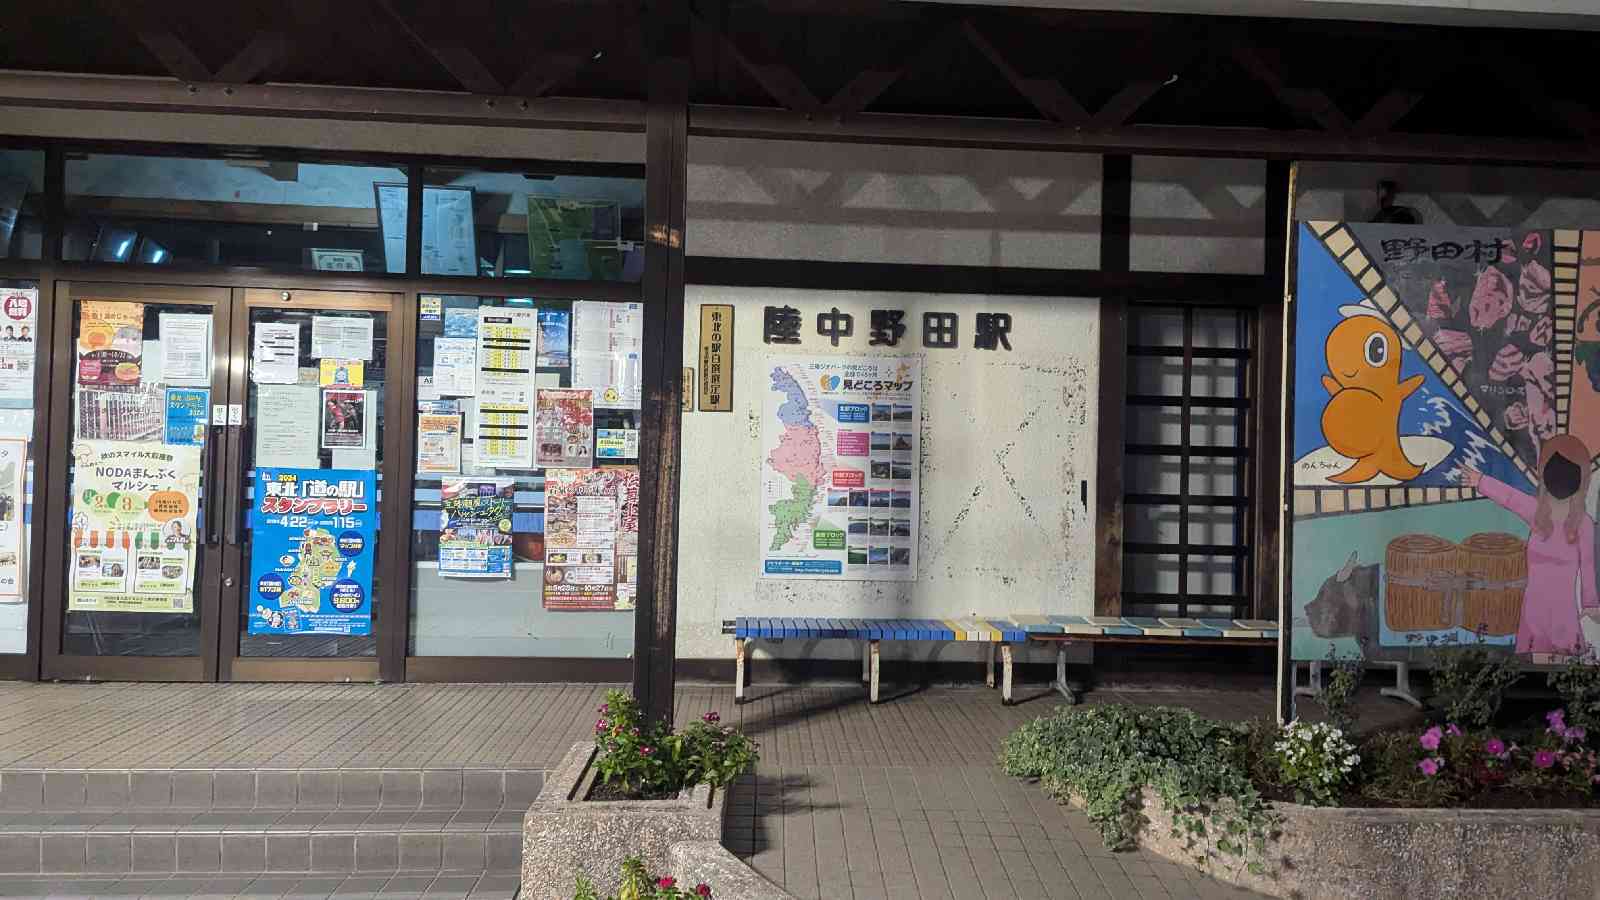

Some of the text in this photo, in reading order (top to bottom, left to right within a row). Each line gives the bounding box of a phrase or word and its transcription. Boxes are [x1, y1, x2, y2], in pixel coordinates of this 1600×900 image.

[1380, 238, 1509, 263] 野田村
[764, 304, 1012, 351] 陸中野田駅
[843, 379, 913, 391] 見どころマップ
[111, 480, 160, 492] マルシェ
[261, 497, 368, 515] スタンプラリー
